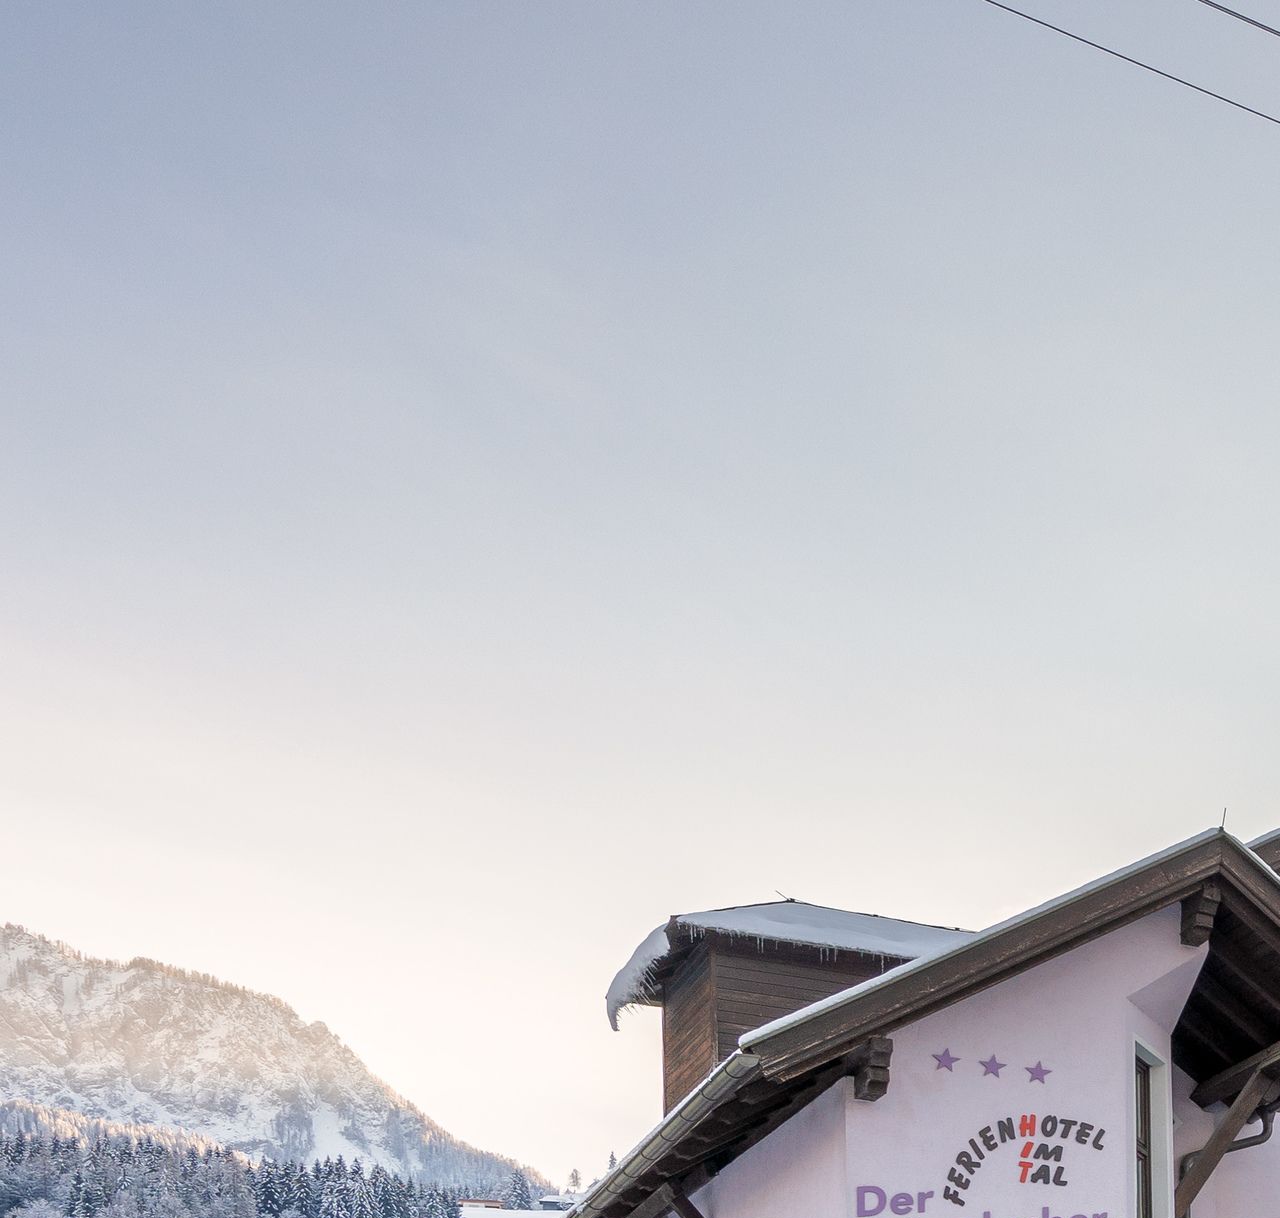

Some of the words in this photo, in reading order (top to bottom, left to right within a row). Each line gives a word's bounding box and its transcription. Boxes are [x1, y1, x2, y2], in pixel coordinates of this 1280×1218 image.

[943, 1114, 1105, 1207] FERIENHOTEL
[1020, 1141, 1063, 1162] IM
[1018, 1161, 1068, 1187] TAL
[856, 1185, 934, 1217] Der
